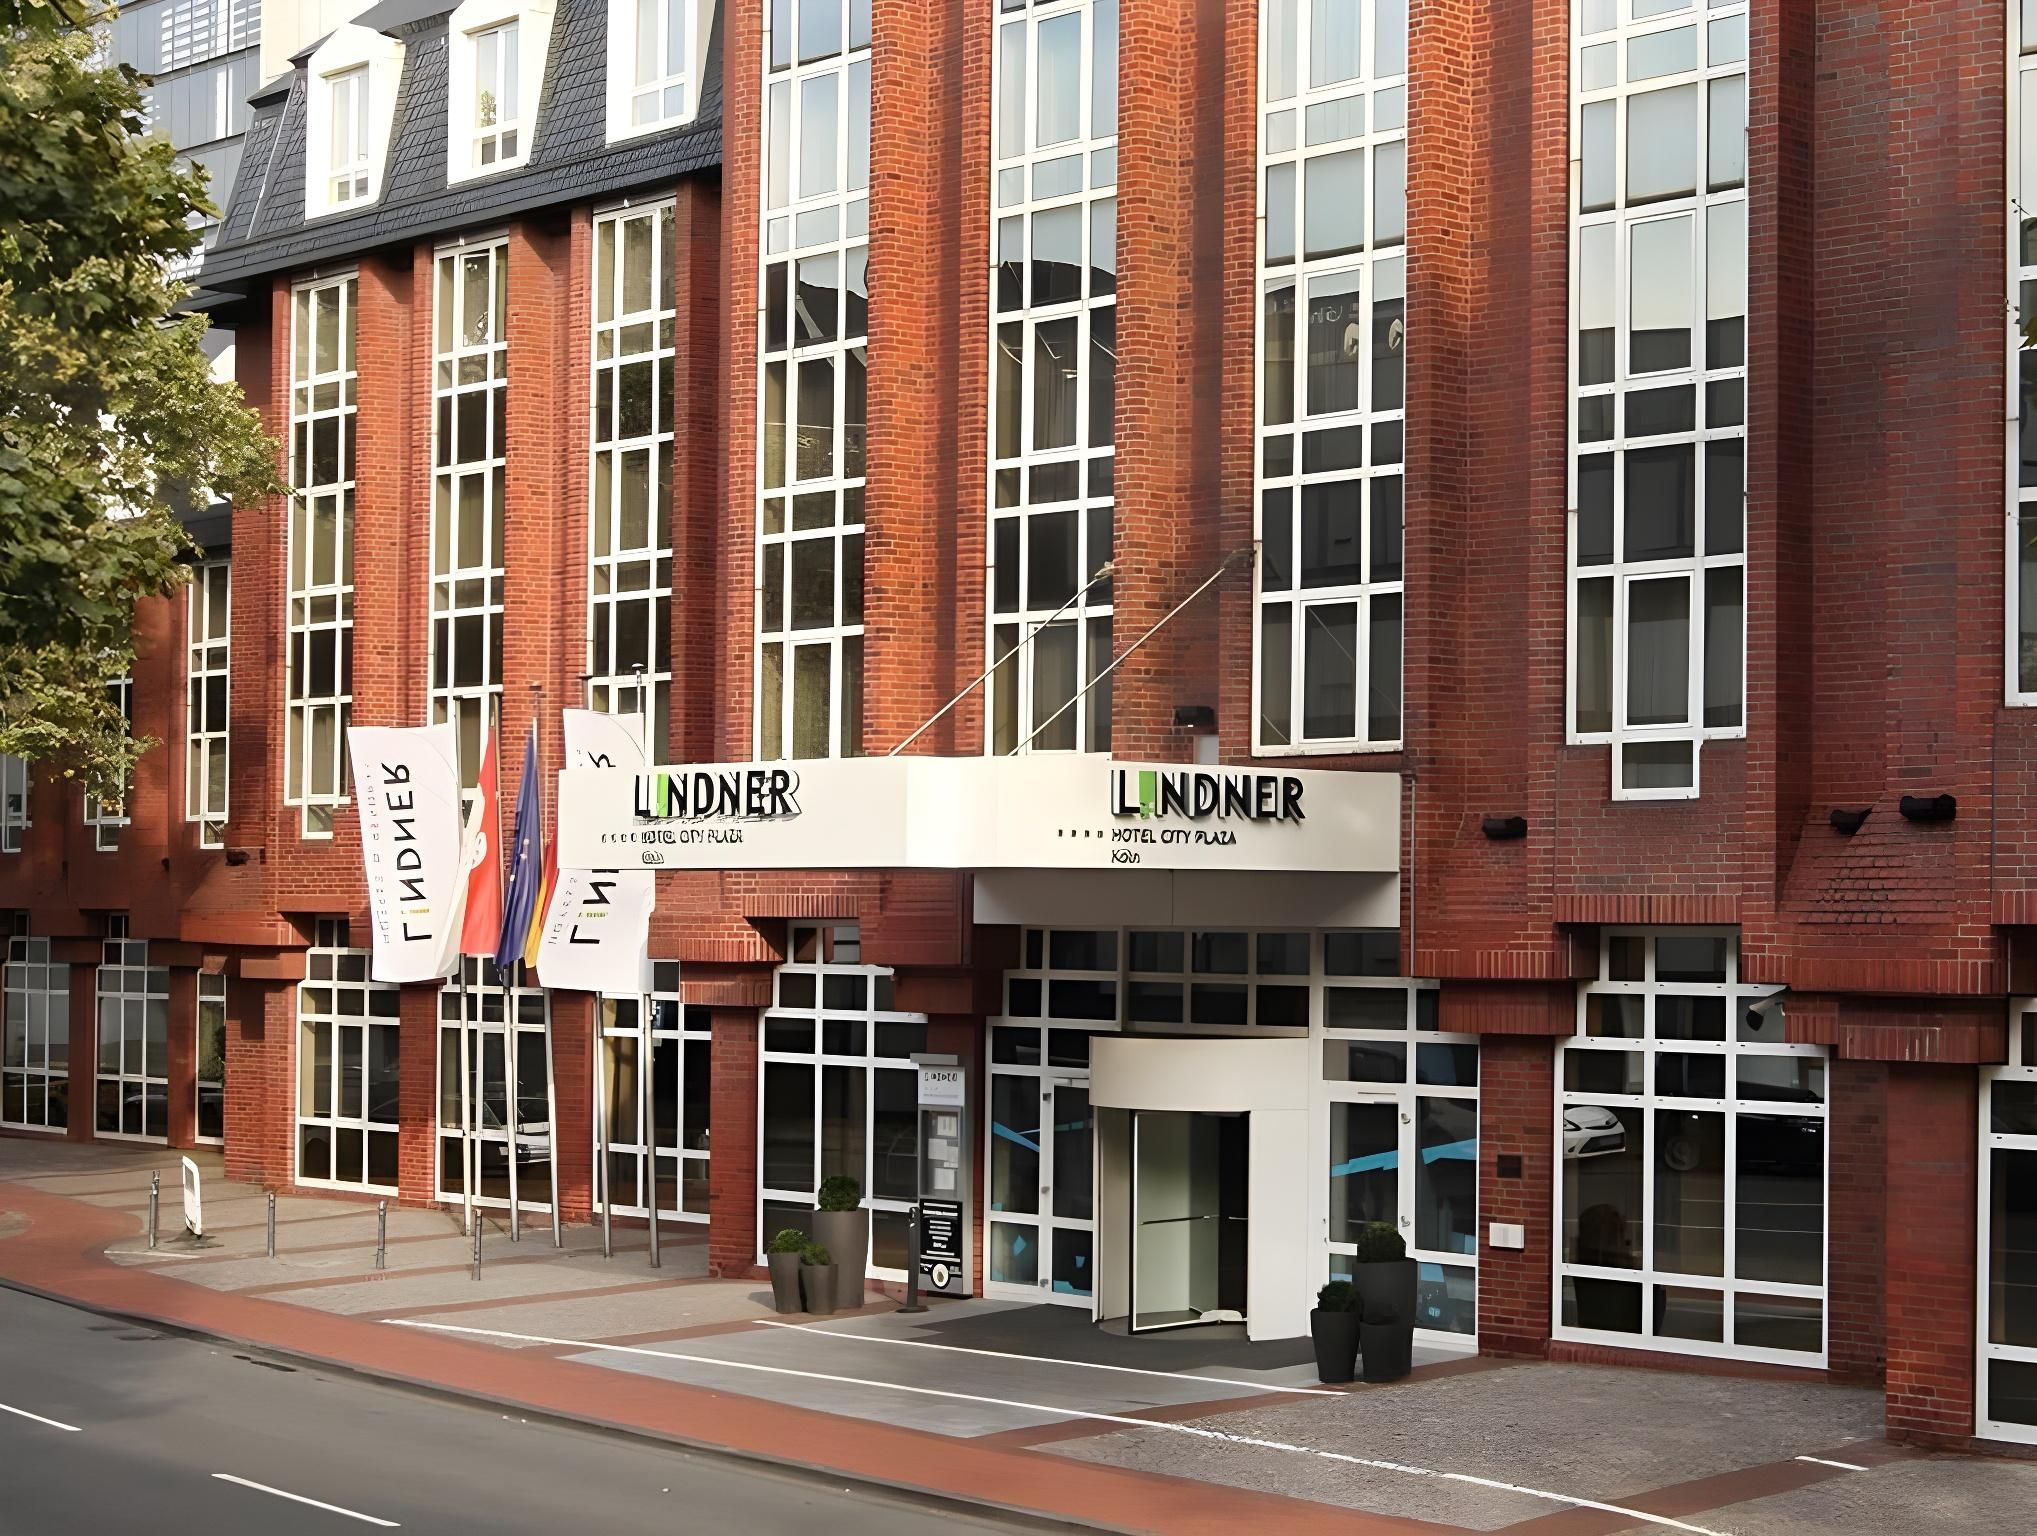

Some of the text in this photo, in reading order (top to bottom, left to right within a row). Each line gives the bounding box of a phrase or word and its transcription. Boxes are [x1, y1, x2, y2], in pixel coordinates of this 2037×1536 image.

[634, 769, 801, 821] LINDNER
[1111, 769, 1305, 822] LINDNER
[1111, 828, 1157, 844] HOTEL
